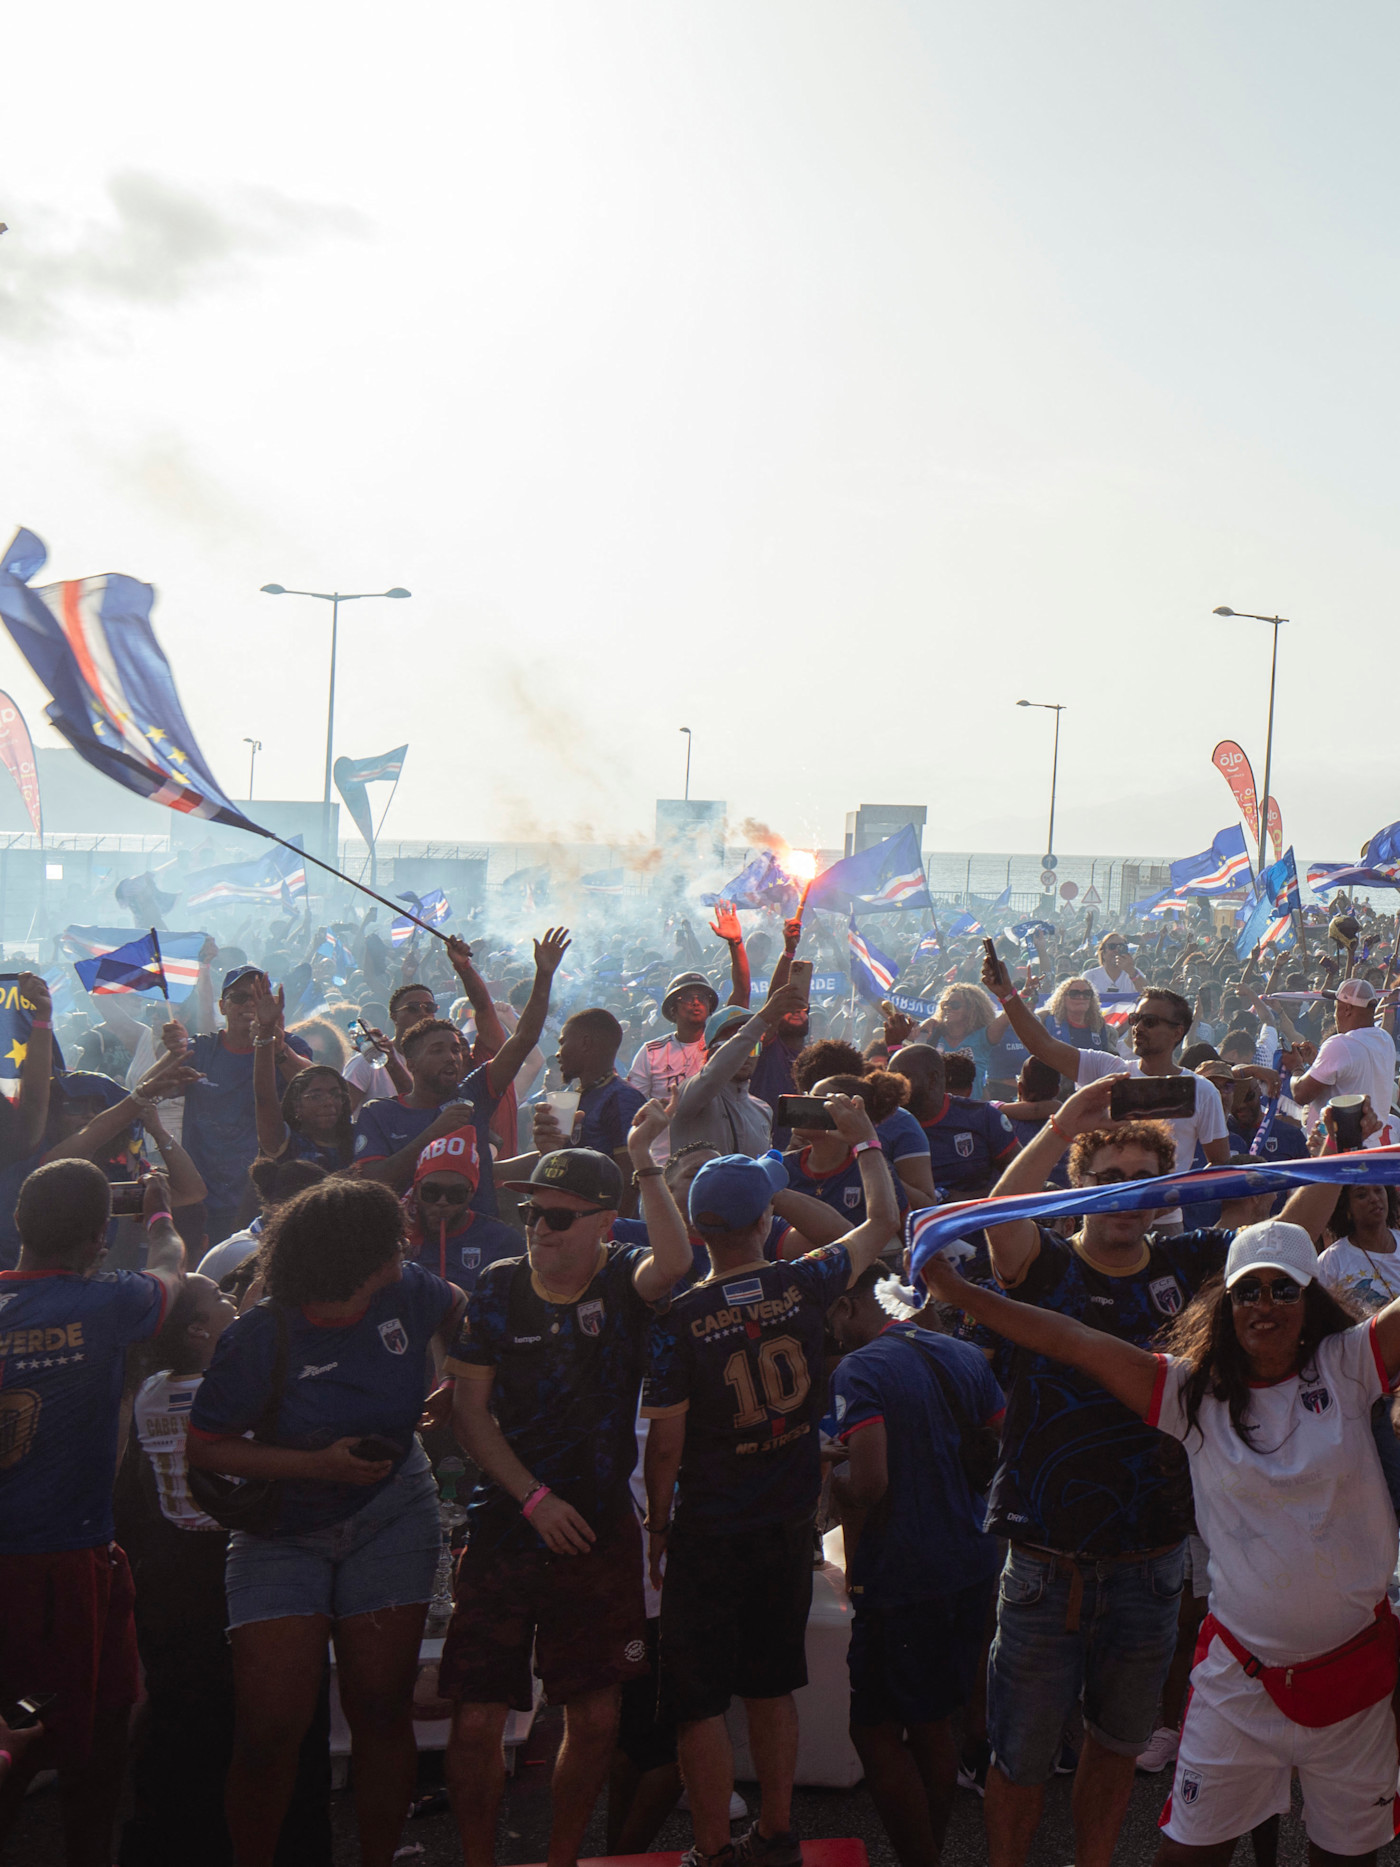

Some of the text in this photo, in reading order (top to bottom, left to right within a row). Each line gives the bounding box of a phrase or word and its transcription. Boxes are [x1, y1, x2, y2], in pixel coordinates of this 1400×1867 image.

[749, 978, 835, 993] AB RDE
[418, 1137, 465, 1165] ABO
[1152, 1279, 1171, 1288] FCF
[690, 1285, 802, 1337] CABO VERDE
[514, 1335, 541, 1344] tempo
[723, 1334, 812, 1429] 10
[146, 1417, 178, 1437] CABO
[736, 1442, 759, 1455] NO
[1007, 1512, 1024, 1523] DRY
